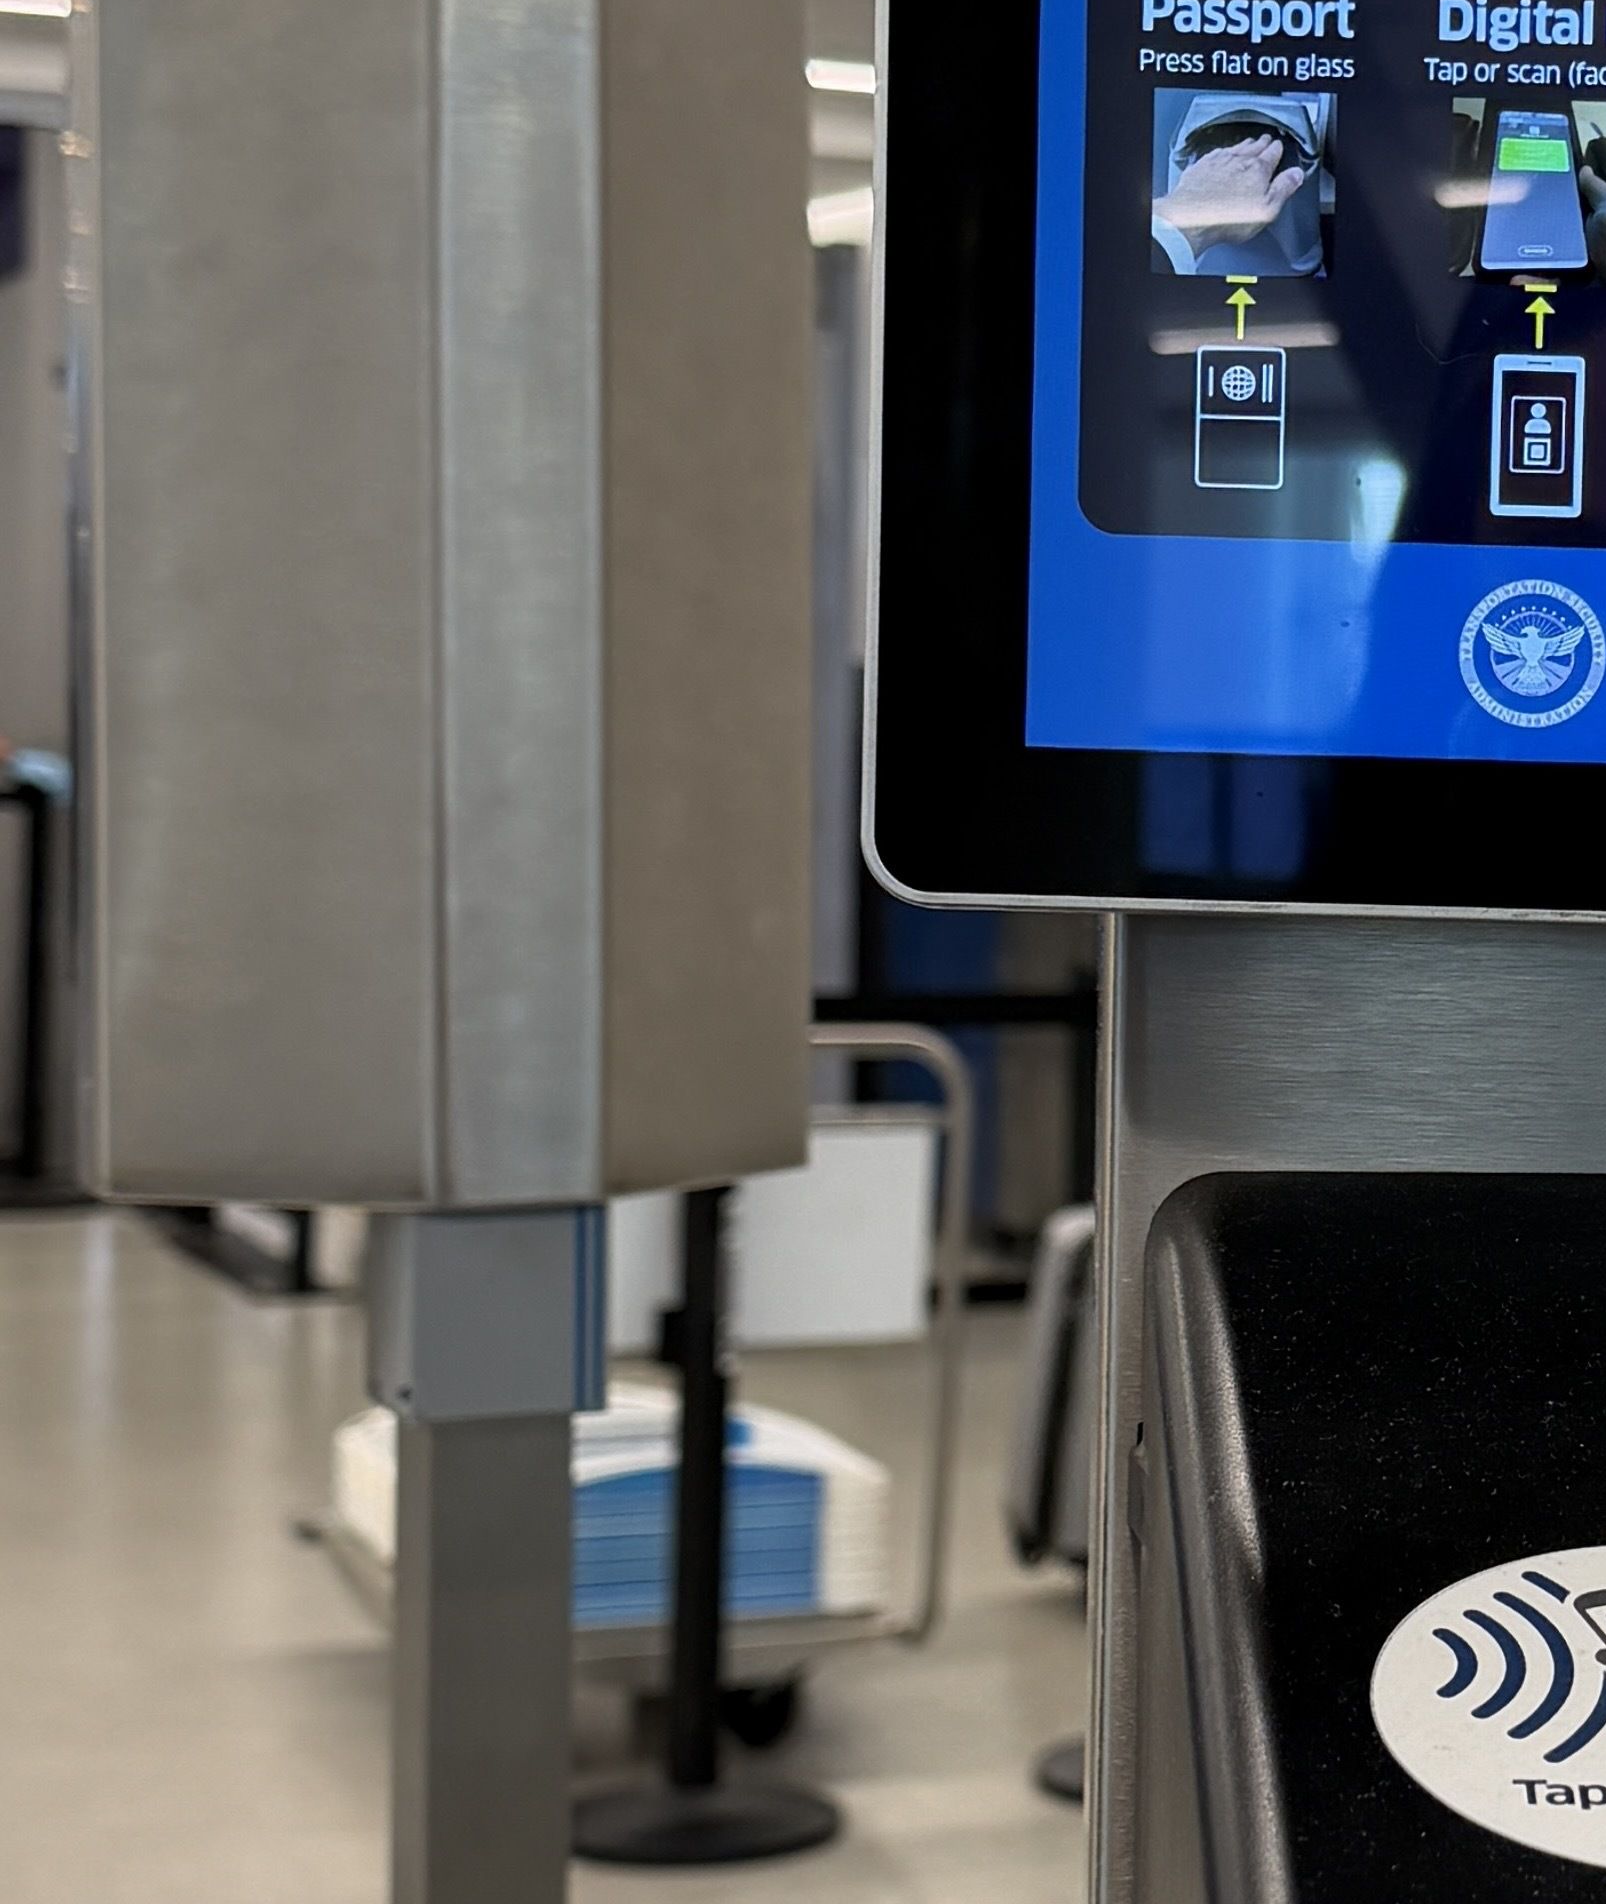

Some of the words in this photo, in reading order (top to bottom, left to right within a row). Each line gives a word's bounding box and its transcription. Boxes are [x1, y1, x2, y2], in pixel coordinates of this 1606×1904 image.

[1139, 48, 1205, 73] Press
[1211, 50, 1252, 75] flat
[1257, 56, 1289, 77] on
[1295, 53, 1355, 81] glass
[1423, 57, 1468, 86] Tap
[1474, 62, 1501, 83] or
[1507, 63, 1561, 85] scan
